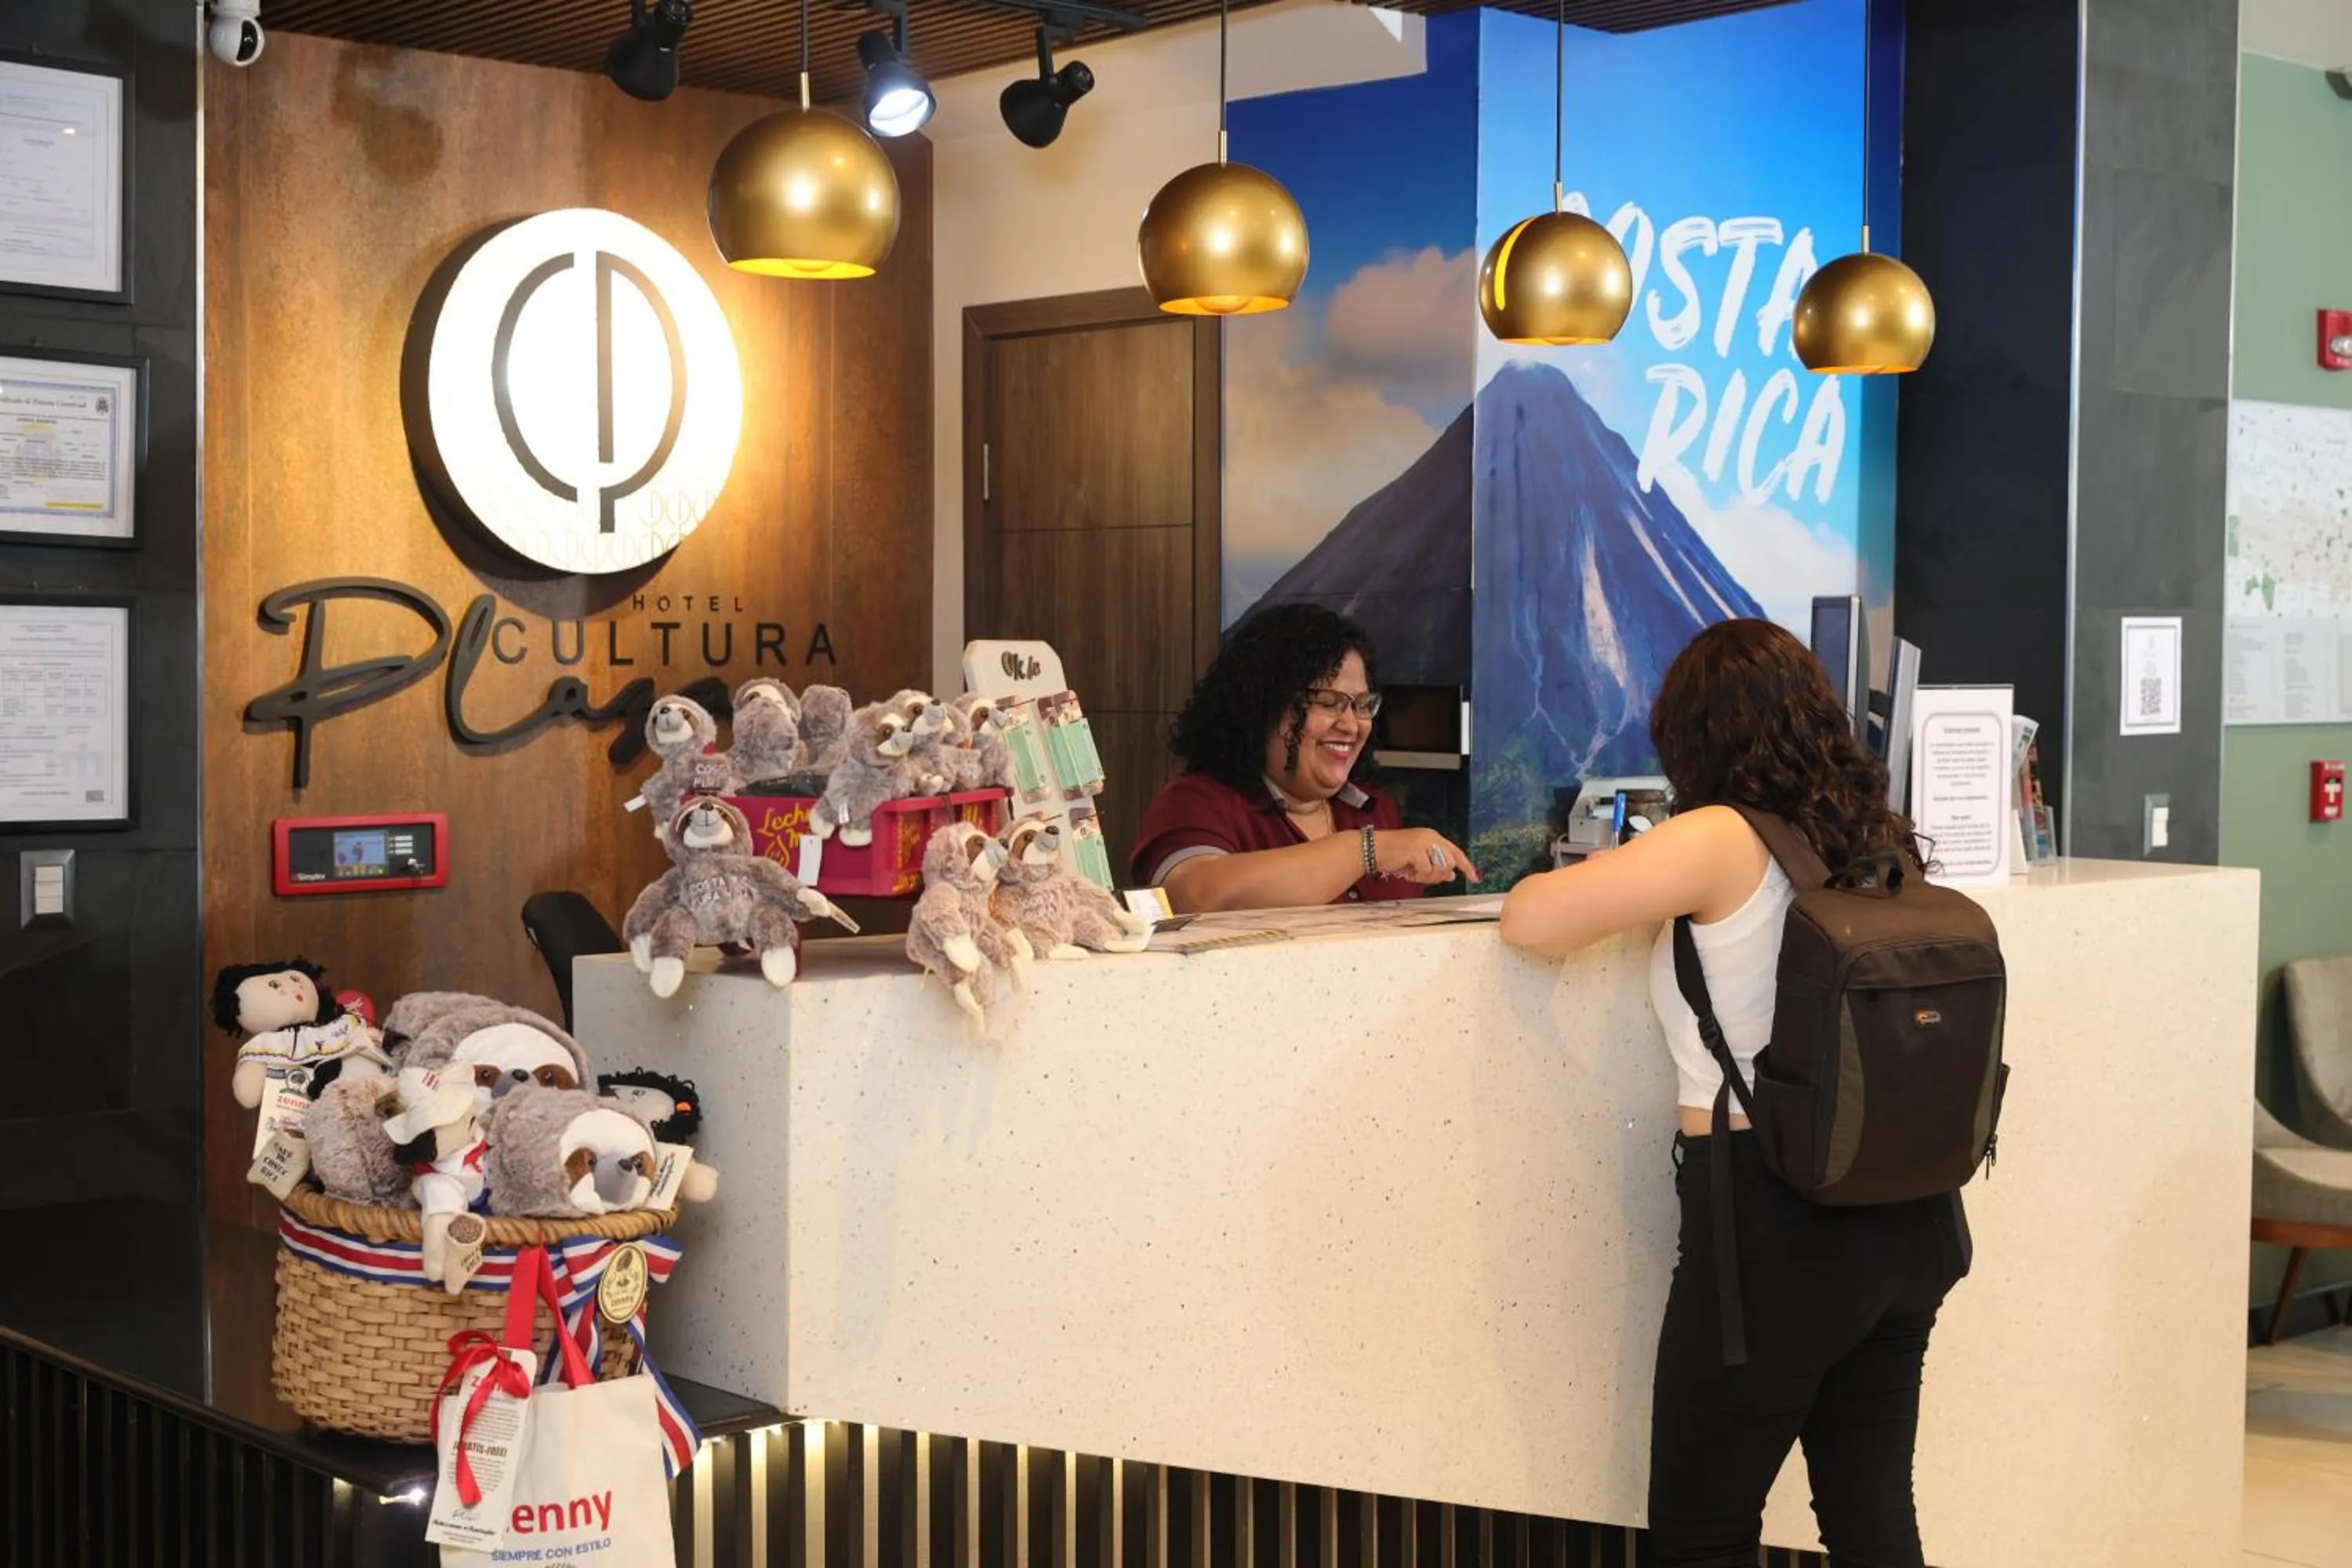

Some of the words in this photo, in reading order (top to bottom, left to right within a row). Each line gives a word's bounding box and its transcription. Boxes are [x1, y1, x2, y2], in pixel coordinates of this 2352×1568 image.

[1563, 191, 1820, 360] OSTA
[1637, 364, 1846, 503] RICA
[633, 594, 744, 612] HOTEL
[492, 617, 837, 667] CULTURA
[505, 1490, 612, 1534] enny
[491, 1547, 543, 1561] SIEMPRE
[545, 1546, 573, 1559] CON
[575, 1537, 612, 1555] ESTILO
